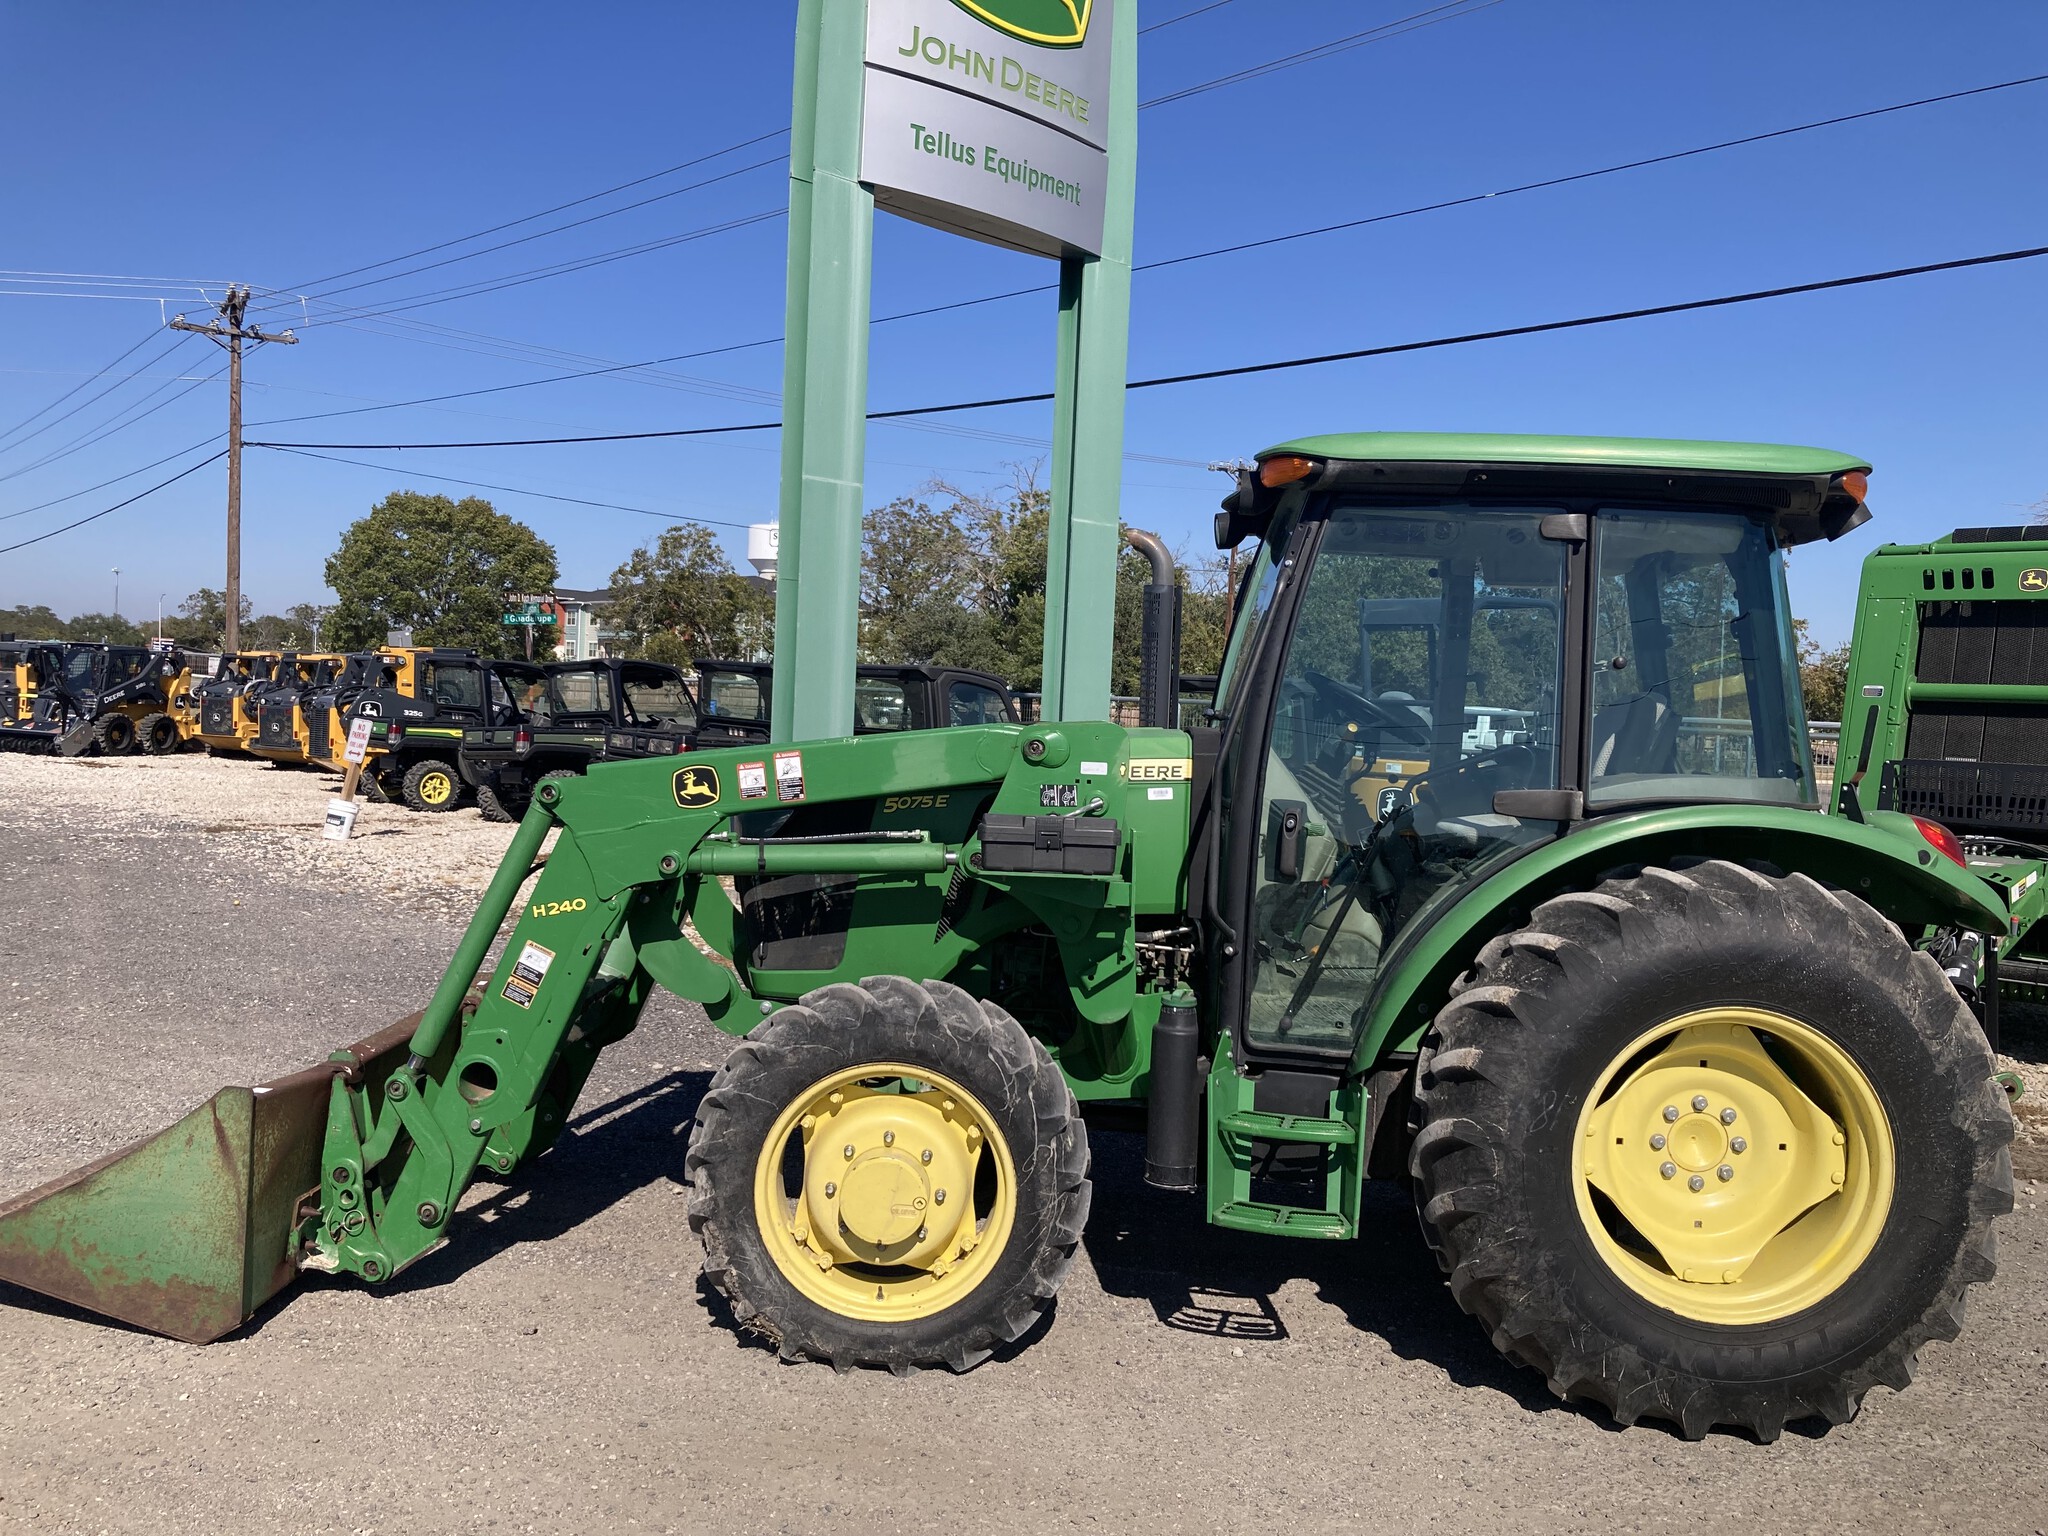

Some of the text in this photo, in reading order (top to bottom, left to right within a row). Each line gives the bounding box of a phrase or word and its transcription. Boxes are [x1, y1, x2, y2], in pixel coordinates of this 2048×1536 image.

[899, 26, 1090, 126] JOHN DEERE
[910, 123, 1081, 206] Tellus Equipment
[104, 689, 125, 703] DEERE
[403, 709, 424, 717] 325G
[357, 723, 366, 732] NO
[352, 730, 367, 740] PARKING
[1131, 766, 1182, 777] EERE
[532, 898, 587, 917] H240
